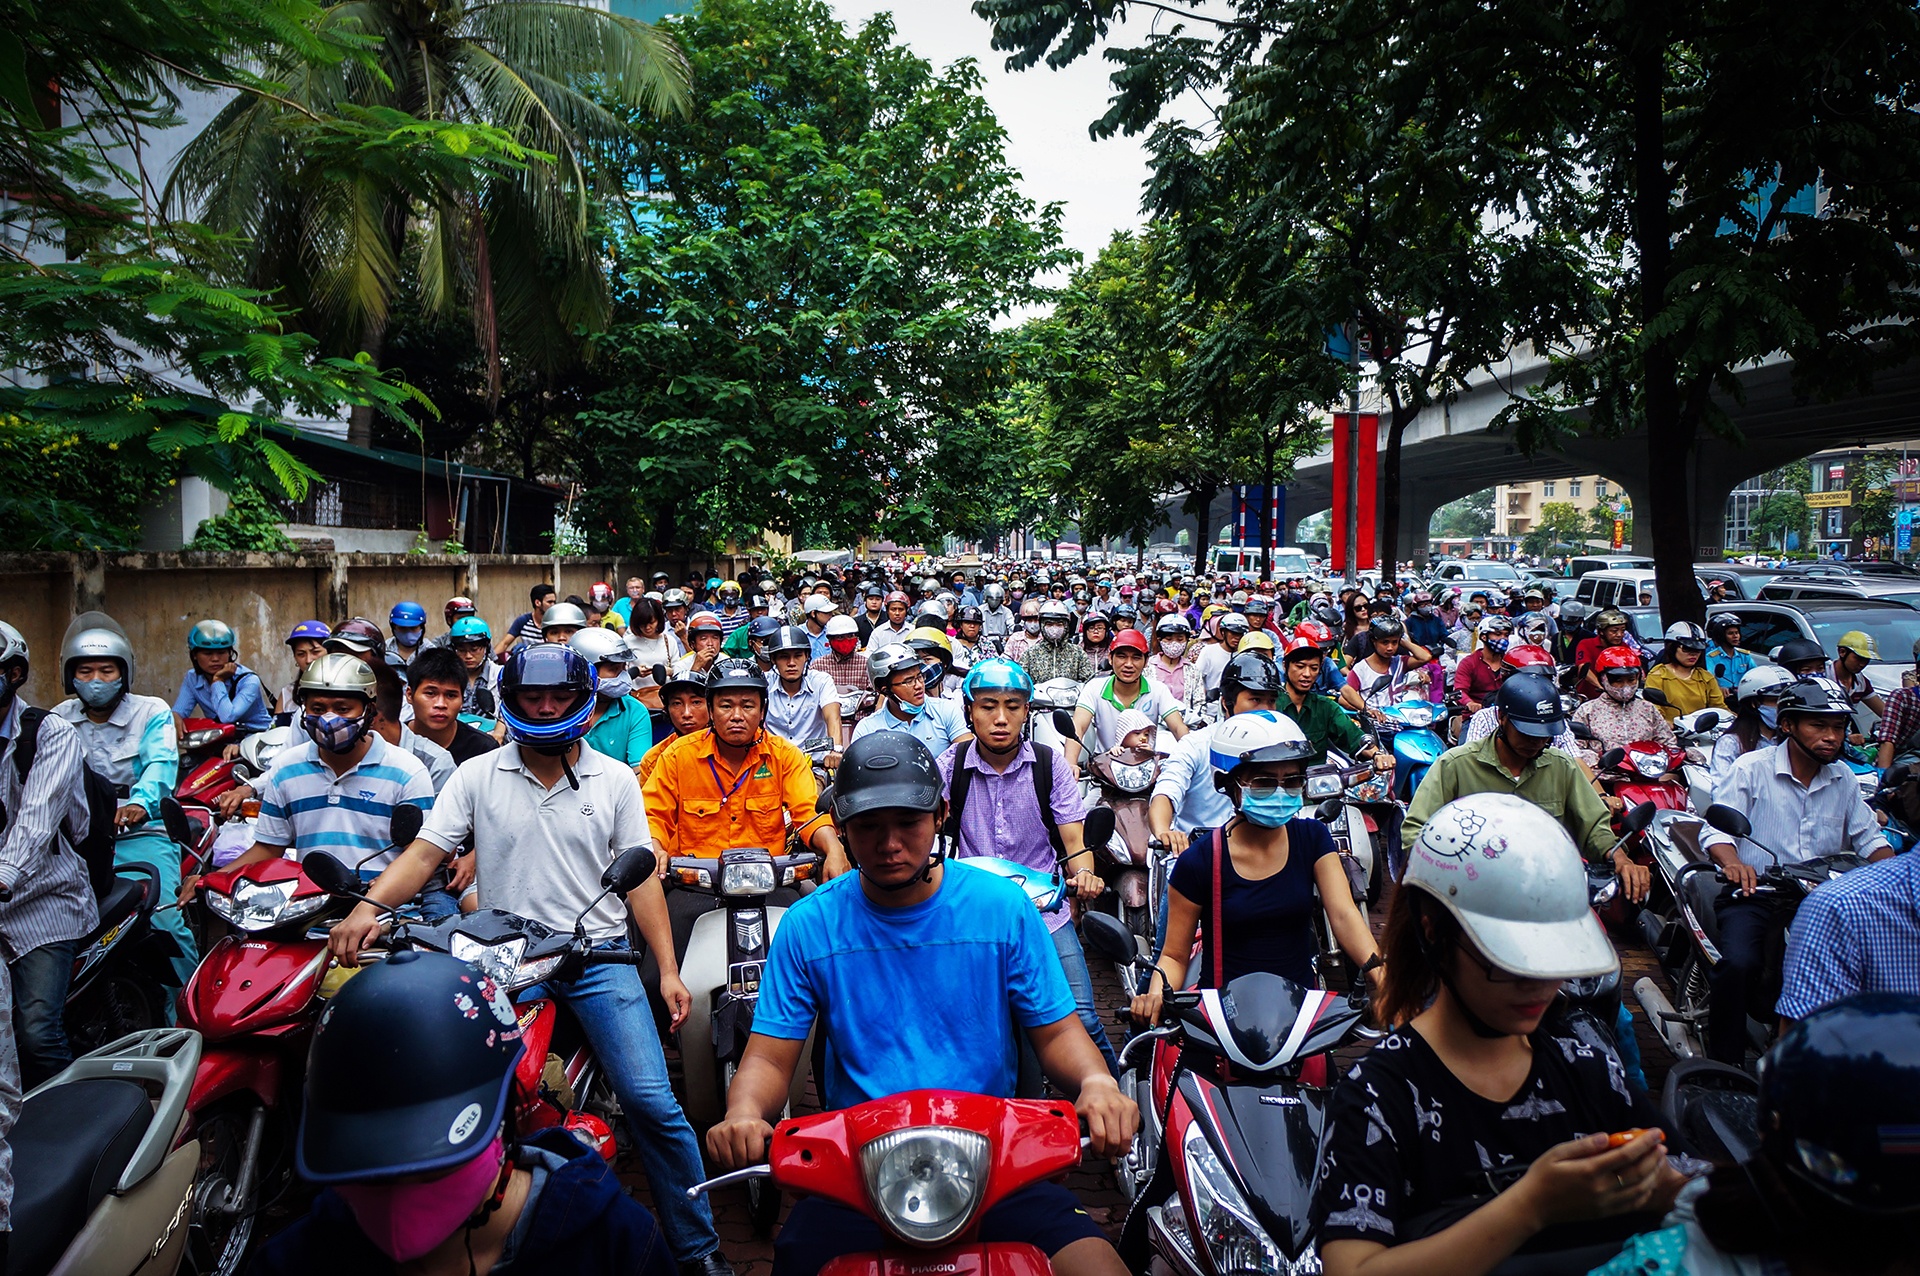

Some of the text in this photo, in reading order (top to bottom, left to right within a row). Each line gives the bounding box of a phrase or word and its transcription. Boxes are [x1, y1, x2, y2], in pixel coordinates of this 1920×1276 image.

[1825, 492, 1849, 500] SHOWROOM
[1700, 547, 1717, 555] T201
[1577, 651, 1585, 661] 3
[1260, 1095, 1301, 1105] HONDA
[455, 1110, 478, 1136] STYLE
[1430, 1096, 1443, 1143] BOY
[1339, 1183, 1386, 1207] BOY
[911, 1263, 956, 1275] PIAGGIO
